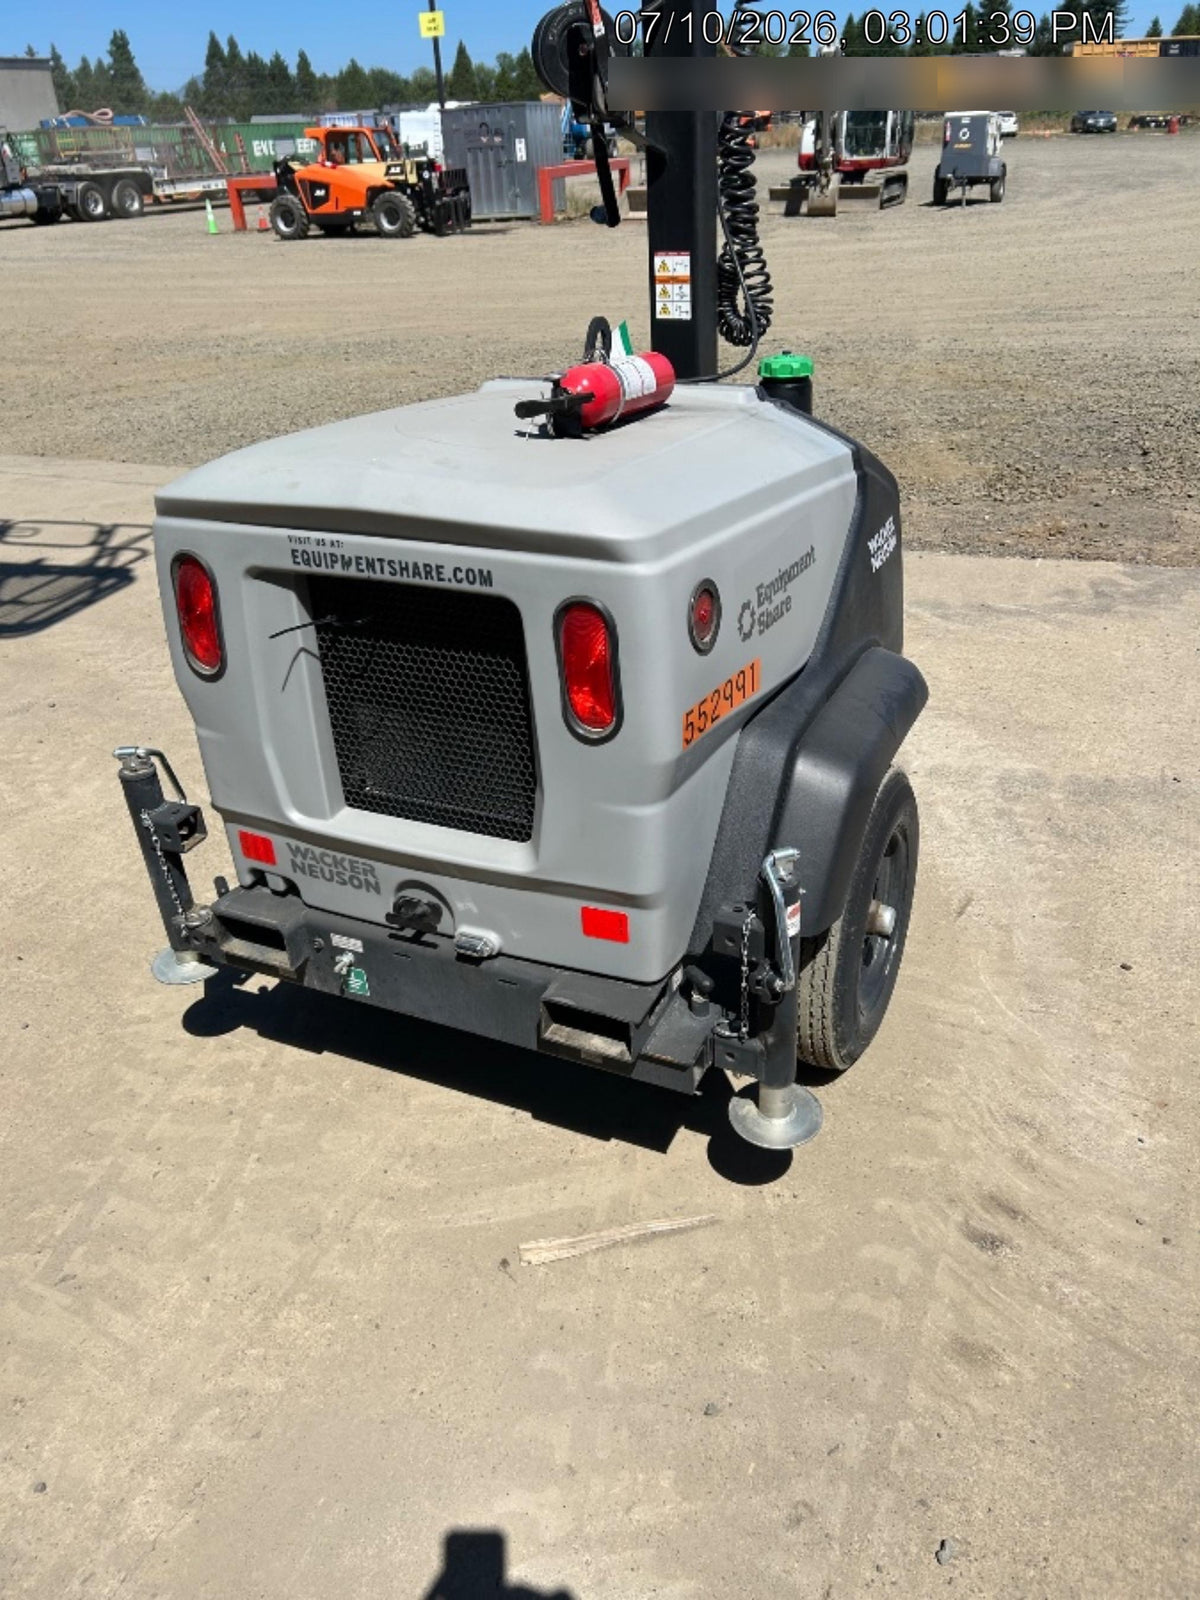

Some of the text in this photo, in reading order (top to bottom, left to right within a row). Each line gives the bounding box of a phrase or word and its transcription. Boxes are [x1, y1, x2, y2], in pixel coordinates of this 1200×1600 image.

[287, 534, 344, 548] VISIT US AT:
[291, 549, 494, 587] EQUIPMENTSHARE.COM
[756, 545, 816, 607] Equipment
[758, 595, 792, 635] Share
[684, 662, 756, 746] 552991
[286, 842, 378, 880] WACKER
[290, 858, 381, 896] NEUSON
